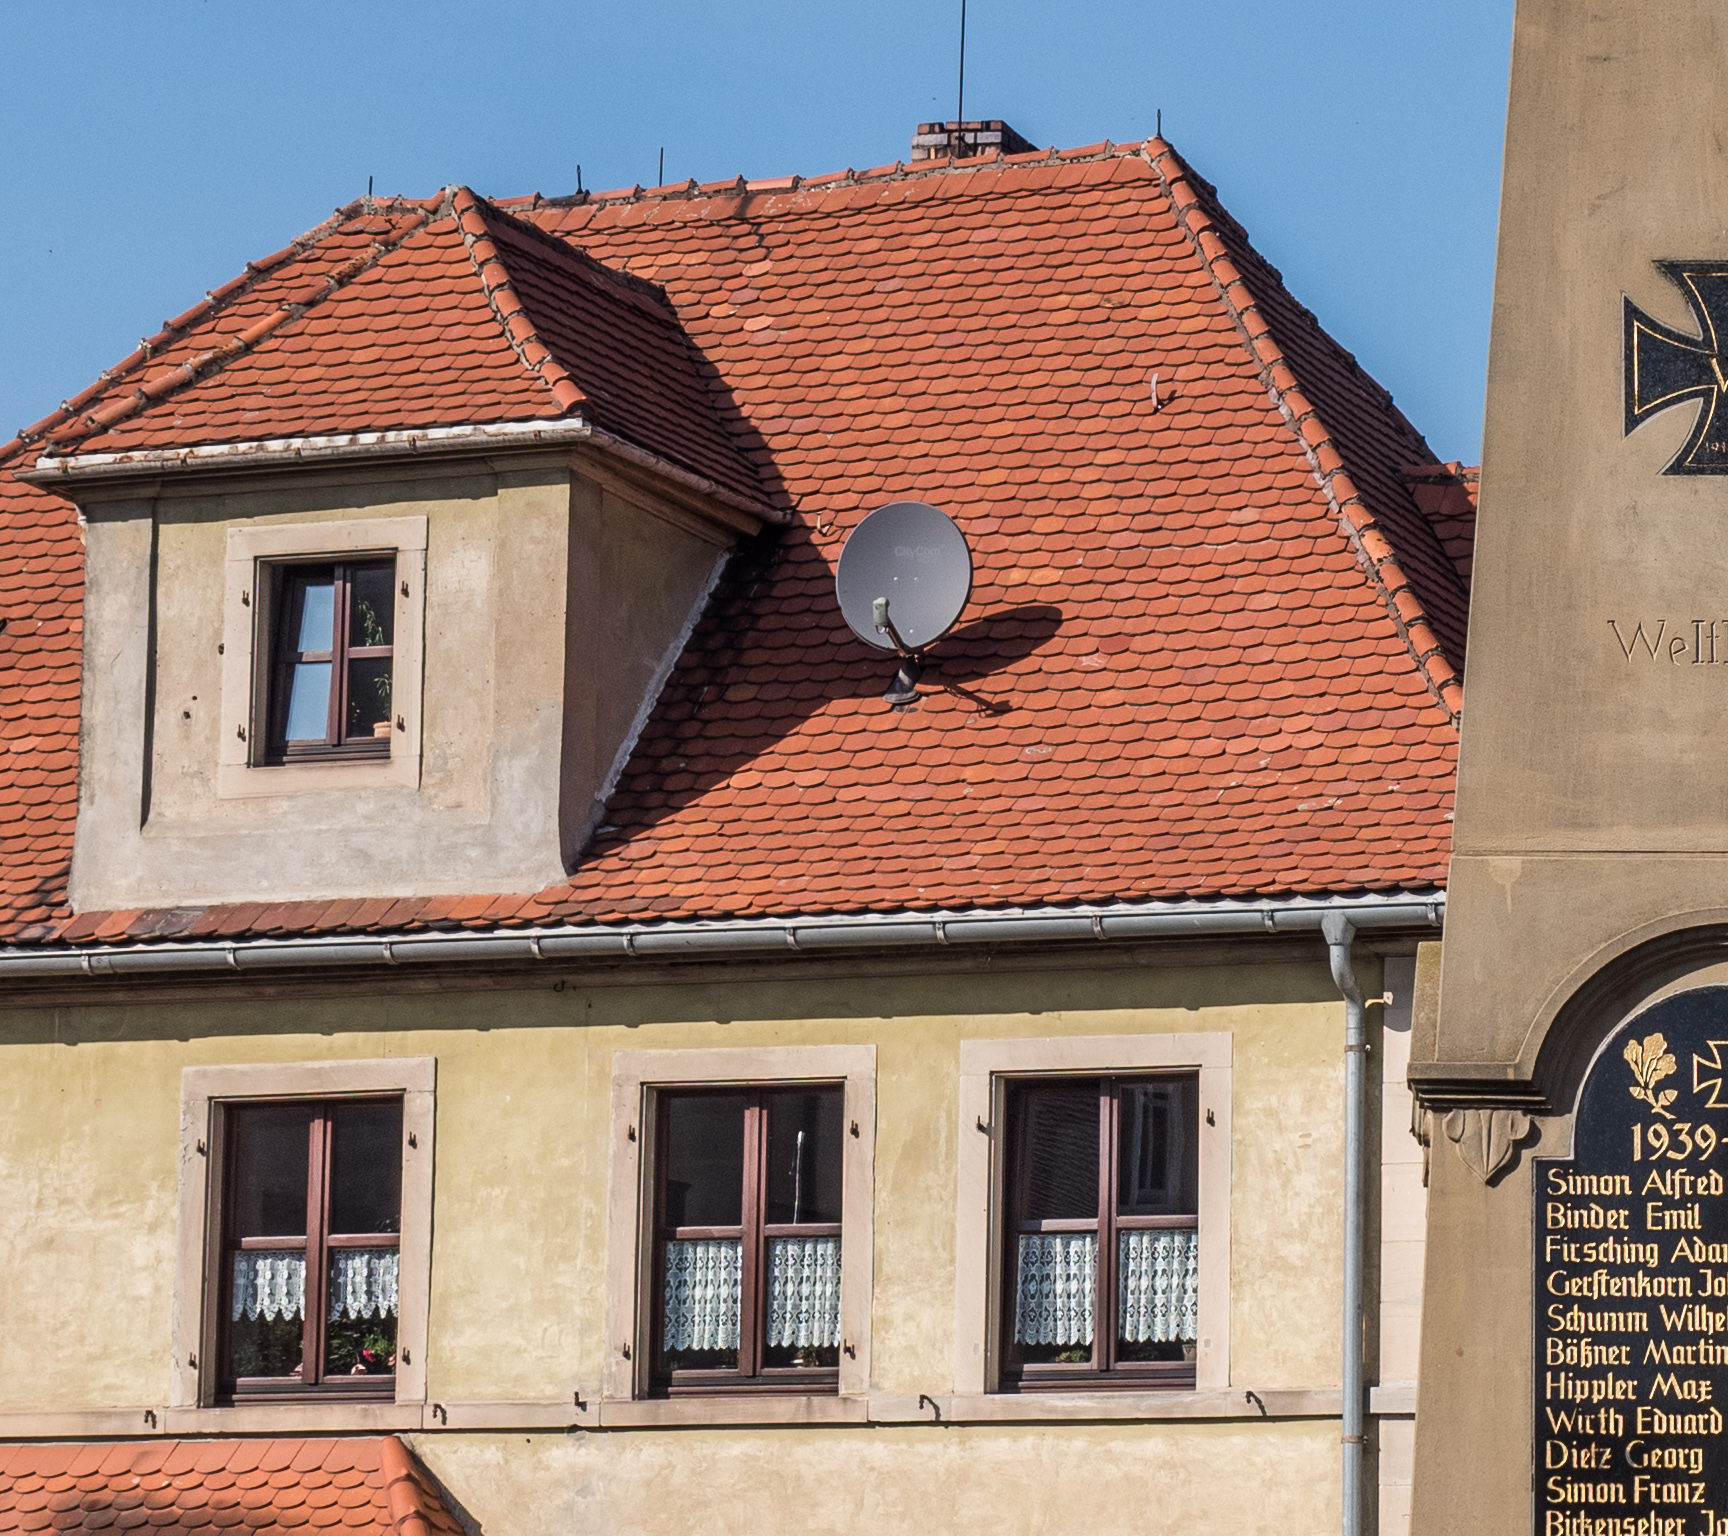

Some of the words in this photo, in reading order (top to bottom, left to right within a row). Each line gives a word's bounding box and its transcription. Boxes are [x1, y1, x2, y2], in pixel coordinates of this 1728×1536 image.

[1546, 1167, 1633, 1196] Simon
[1641, 1167, 1724, 1201] Alfred
[1546, 1201, 1630, 1231] Binder
[1646, 1201, 1703, 1231] Emil
[1545, 1234, 1659, 1269] Firsching
[1547, 1303, 1649, 1334] Schumm
[1545, 1370, 1638, 1404] Hippler
[1648, 1371, 1713, 1404] Max
[1545, 1406, 1624, 1438] Wirth
[1636, 1405, 1723, 1435] Eduard
[1545, 1439, 1612, 1470] Dietz
[1625, 1439, 1703, 1475] Georg
[1546, 1475, 1627, 1504] Simon
[1633, 1474, 1706, 1504] Franz
